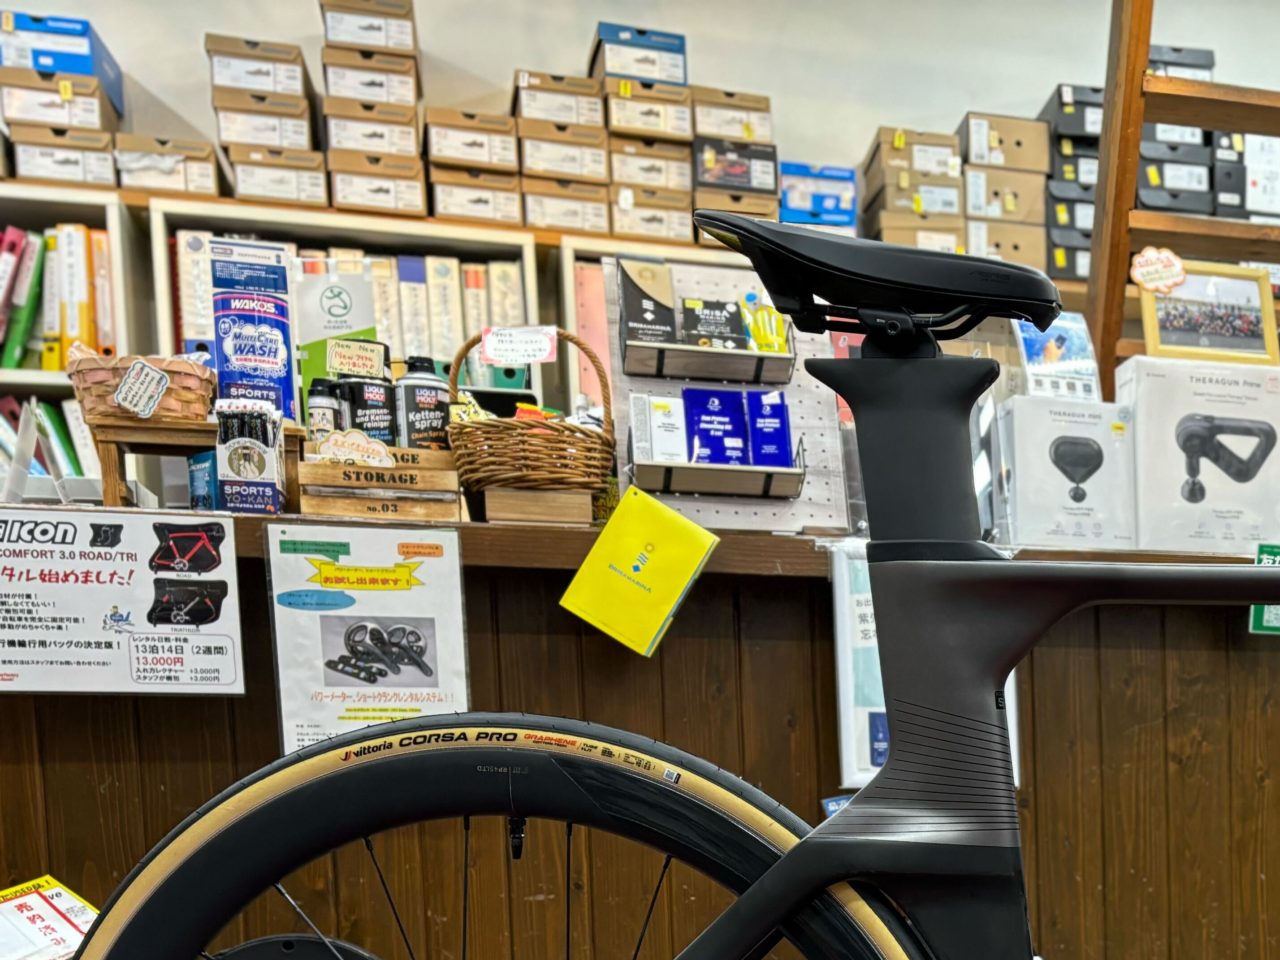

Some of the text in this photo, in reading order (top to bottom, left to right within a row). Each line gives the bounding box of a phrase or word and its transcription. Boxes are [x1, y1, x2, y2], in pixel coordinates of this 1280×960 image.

[234, 344, 279, 358] WASH
[1189, 376, 1239, 387] THERAGUN
[230, 388, 276, 399] SPORTS
[409, 411, 444, 422] Ketten-
[415, 418, 443, 430] spray
[343, 470, 418, 485] STORAGE
[224, 485, 273, 496] SPORTS
[225, 495, 273, 504] YO-KAN
[60, 550, 76, 560] 3.0
[79, 551, 138, 562] ROAD/TRI
[323, 576, 410, 586] お試し出来ます！
[0, 616, 85, 624] 自転車を完全に固定可能！
[135, 644, 184, 655] 13泊14日
[135, 656, 184, 667] 13.000円
[352, 732, 518, 758] vittoria CORSA PRO
[524, 733, 577, 746] GRAPHENE
